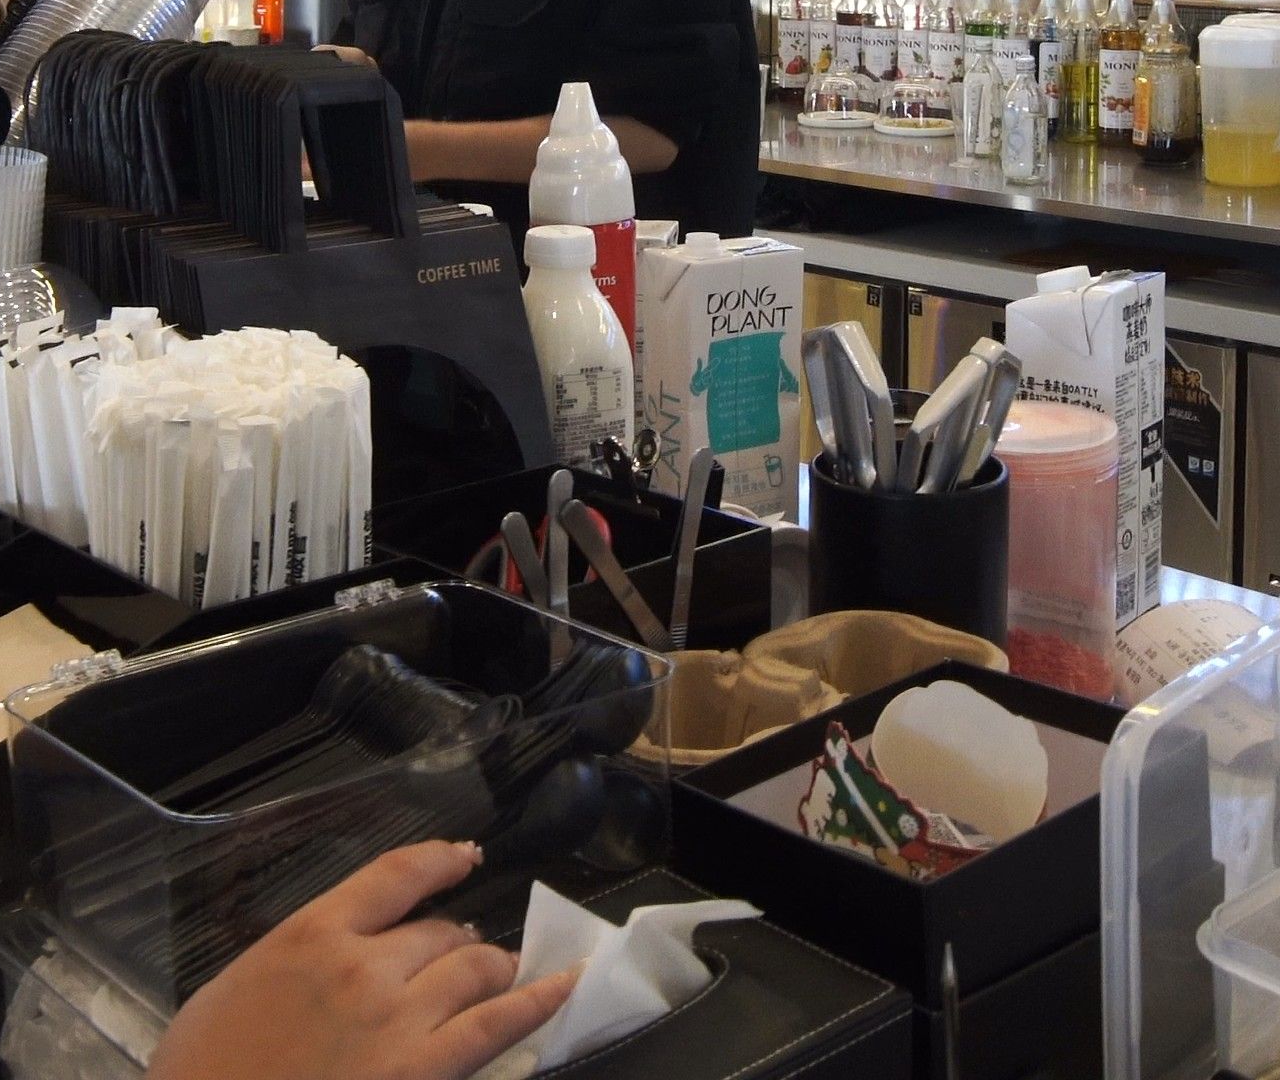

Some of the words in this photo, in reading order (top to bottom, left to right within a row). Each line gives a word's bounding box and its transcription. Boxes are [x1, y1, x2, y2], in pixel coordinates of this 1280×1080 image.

[1104, 61, 1137, 70] MONI
[417, 264, 467, 284] COFFEE
[468, 257, 501, 276] TIME
[707, 285, 777, 315] DONG
[711, 306, 793, 337] PLANT
